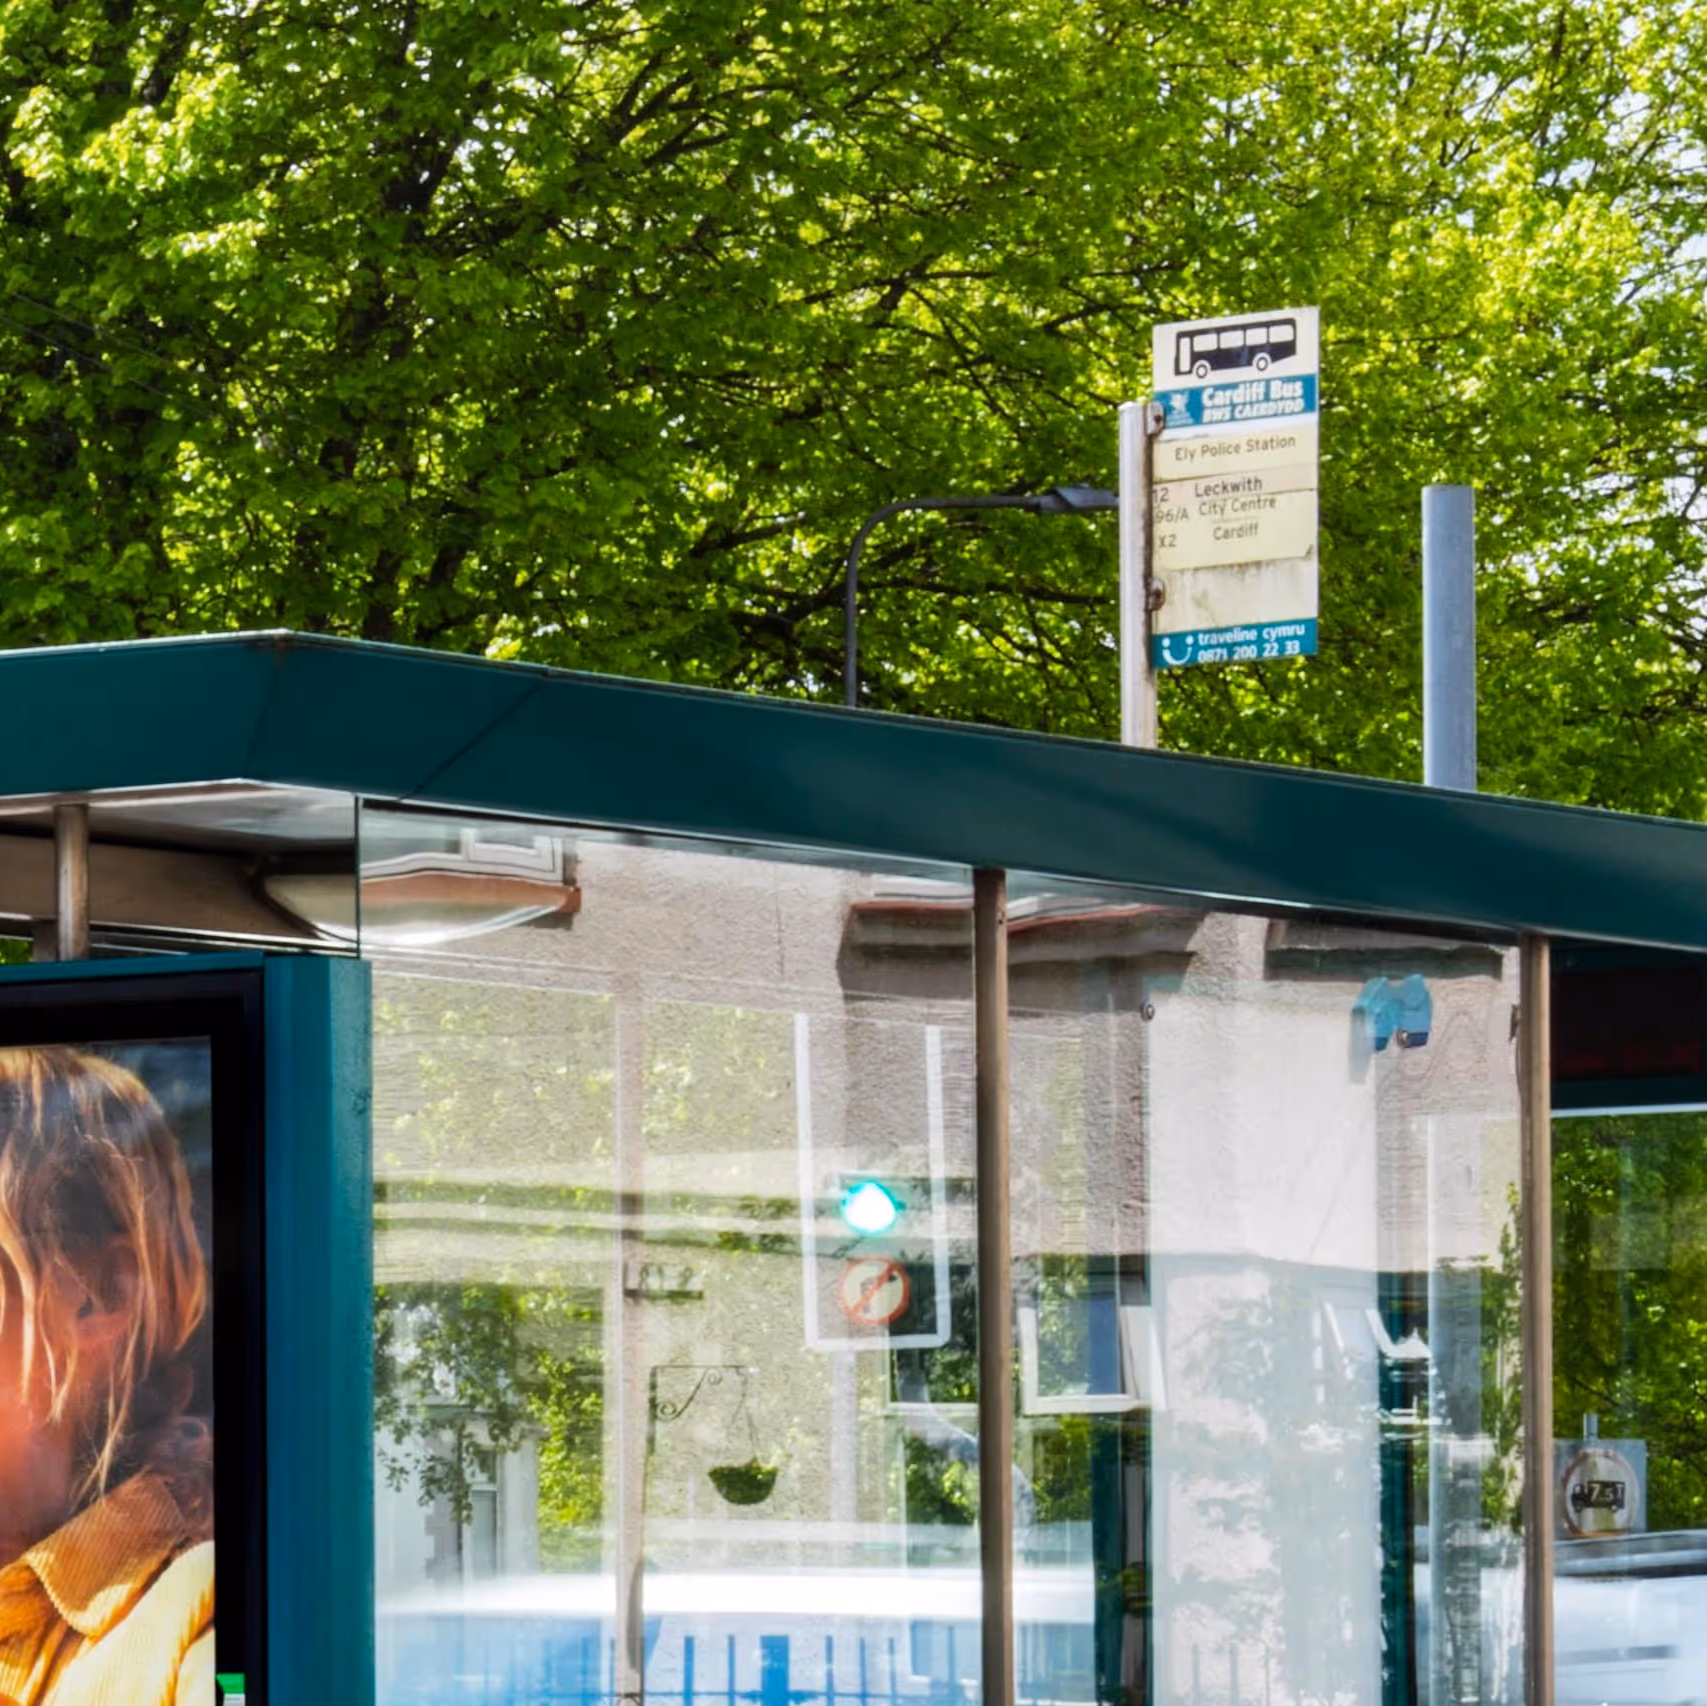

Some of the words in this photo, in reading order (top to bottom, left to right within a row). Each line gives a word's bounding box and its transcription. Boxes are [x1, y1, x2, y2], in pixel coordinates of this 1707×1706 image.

[1202, 381, 1265, 407] Cardiff
[1270, 380, 1303, 399] Bus
[1202, 406, 1232, 423] BWS
[1234, 399, 1304, 419] CAERDYDD
[1175, 448, 1196, 463] Ely
[1201, 442, 1241, 458] Police
[1246, 436, 1296, 452] Station
[1195, 477, 1263, 497] Leckwith
[1155, 507, 1189, 524] 96/A
[1199, 500, 1226, 516] City
[1232, 496, 1276, 512] Centre
[1158, 534, 1177, 548] X2
[1213, 522, 1258, 540] Cardiff
[1198, 627, 1257, 645] traveline
[1262, 624, 1305, 642] cymru
[1233, 645, 1257, 660] 200
[1262, 642, 1279, 657] 22
[1285, 639, 1300, 654] 33
